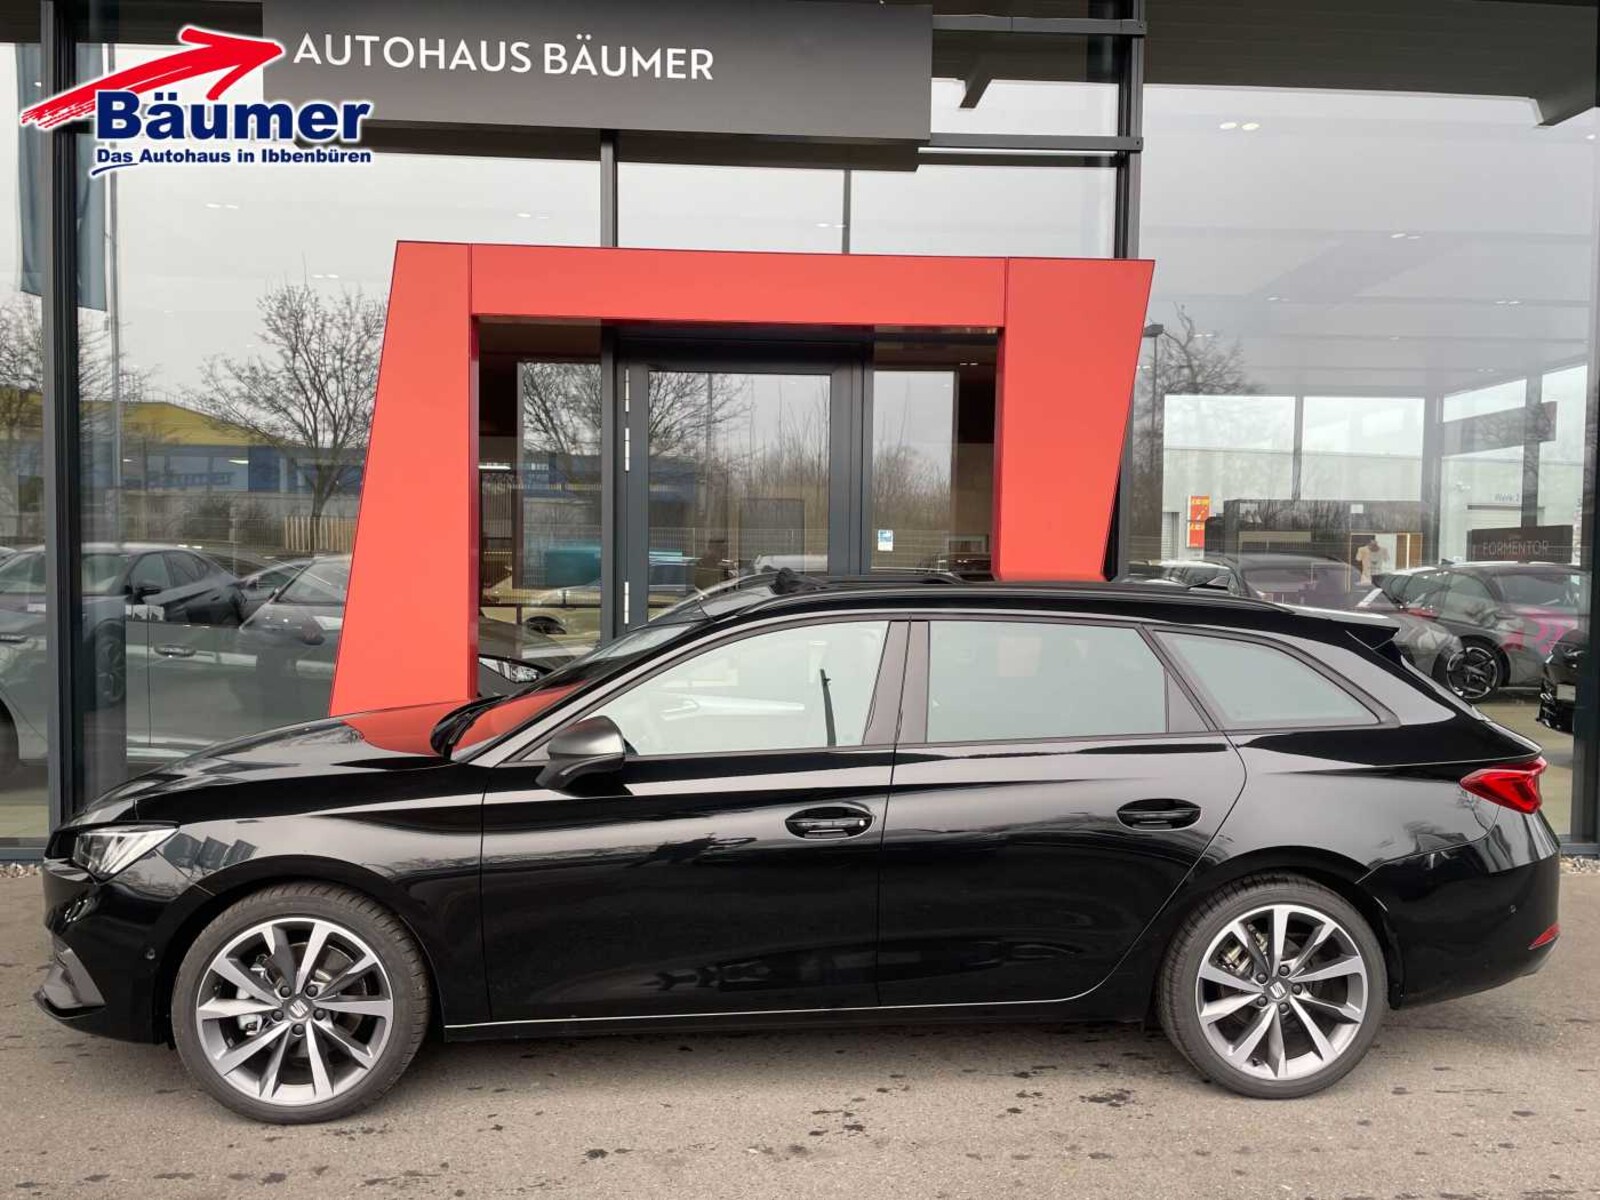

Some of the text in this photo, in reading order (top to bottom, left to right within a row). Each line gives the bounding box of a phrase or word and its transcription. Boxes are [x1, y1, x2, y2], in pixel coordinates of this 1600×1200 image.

[293, 33, 715, 81] AUTOHAUS BÄUMER
[1482, 539, 1550, 558] FORMENTOR
